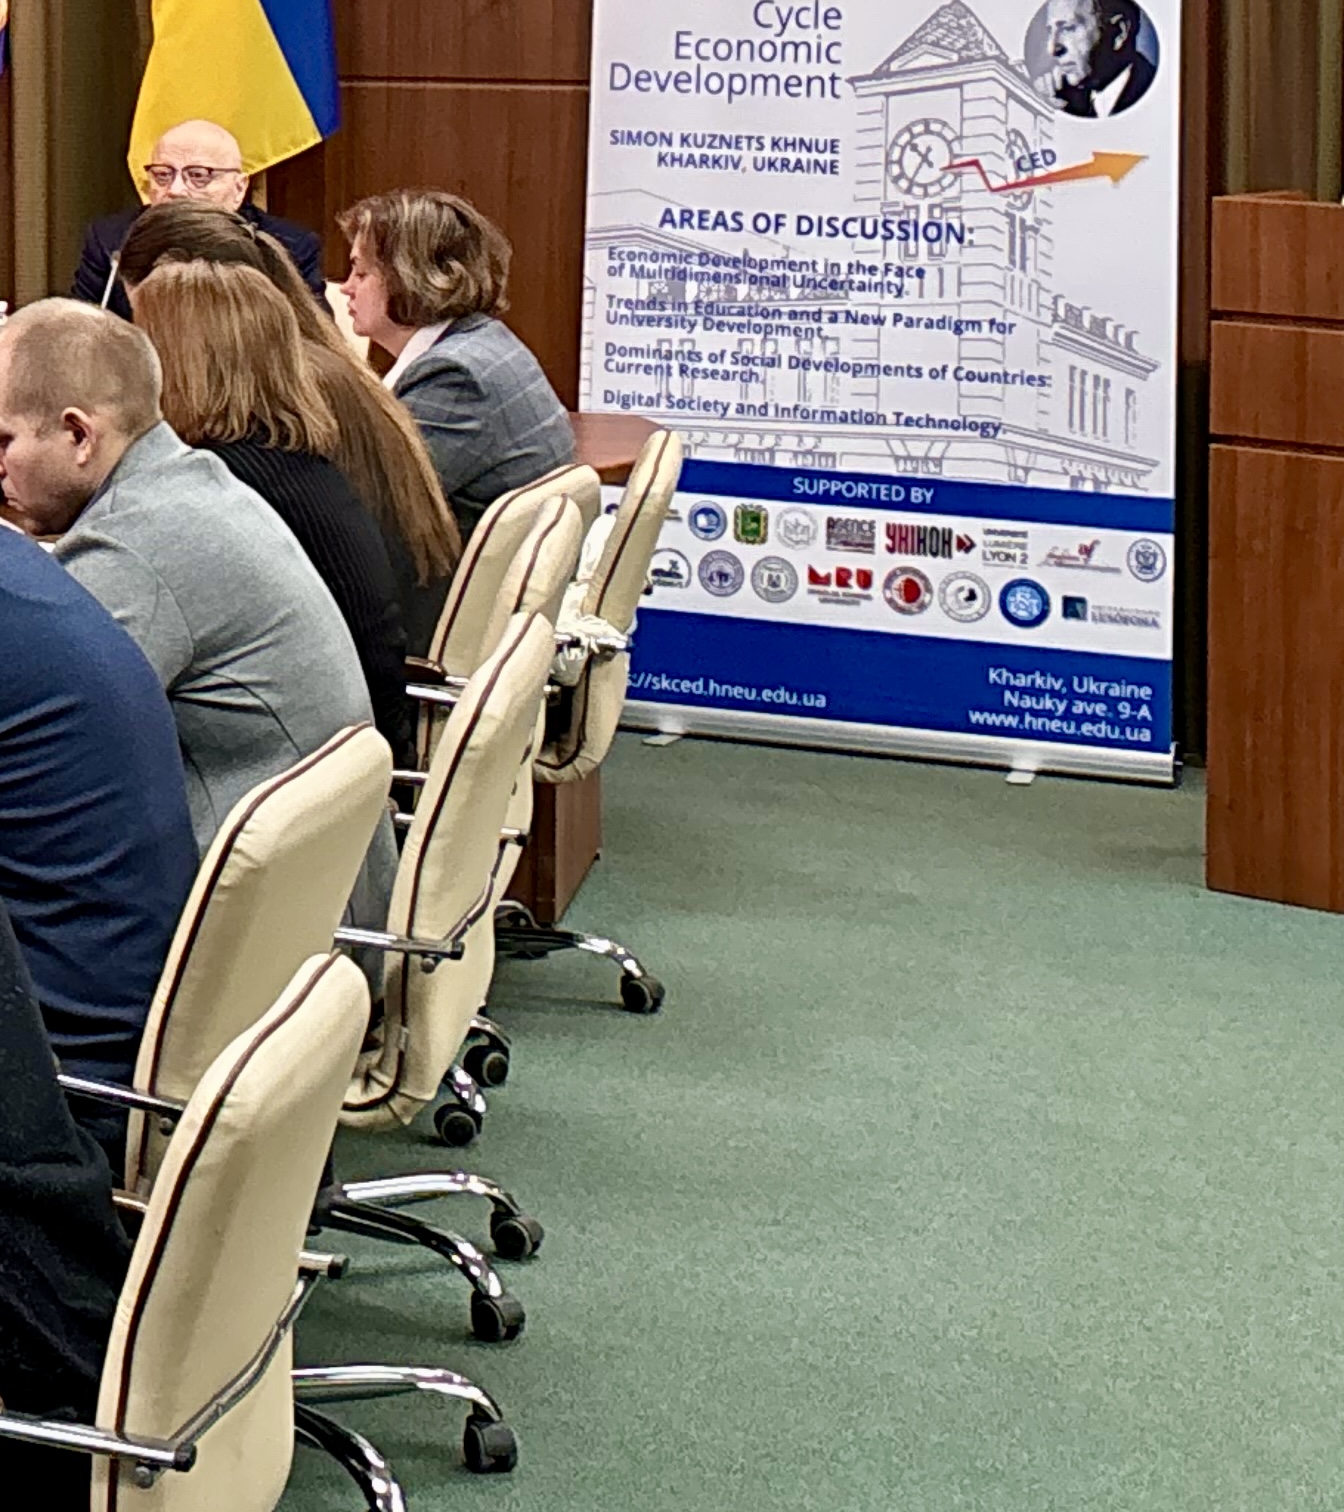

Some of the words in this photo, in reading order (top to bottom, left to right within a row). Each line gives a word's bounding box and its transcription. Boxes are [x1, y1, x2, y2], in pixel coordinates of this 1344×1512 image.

[674, 31, 842, 64] Economic
[610, 62, 842, 104] Development
[610, 129, 674, 148] SIMON
[680, 132, 766, 151] KUZNETS
[771, 136, 840, 155] KHNUE
[657, 152, 747, 174] KHARKIV,
[753, 156, 840, 176] UKRAINE
[1016, 148, 1057, 172] CED
[658, 208, 744, 232] AREAS
[752, 212, 787, 235] OF
[796, 215, 975, 246] DISCUSSION:
[608, 246, 692, 266] Economic
[698, 252, 818, 274] Development
[824, 258, 841, 275] in
[848, 260, 879, 277] the
[884, 262, 926, 279] Face
[607, 263, 625, 278] of
[629, 264, 788, 287] Multidimensional
[793, 274, 910, 298] Uncertainty.
[606, 310, 698, 334] University
[607, 294, 668, 312] Trends
[672, 298, 688, 314] in
[694, 300, 782, 320] Education
[788, 306, 822, 323] and
[827, 312, 838, 324] a
[845, 310, 886, 326] New
[892, 312, 982, 335] Paradigm
[989, 318, 1016, 335] for
[604, 342, 703, 362] Dominants
[708, 349, 727, 364] of
[730, 351, 782, 369] Social
[788, 355, 923, 380] Developments
[928, 364, 948, 380] of
[604, 358, 674, 378] Current
[604, 390, 660, 410] Digital
[666, 395, 731, 418] Society
[736, 401, 768, 418] and
[774, 403, 887, 426] Information
[793, 477, 906, 502] SUPPORTED
[910, 486, 935, 504] BY
[982, 550, 1016, 564] LYON
[1020, 552, 1029, 565] 2
[988, 668, 1067, 694] Kharkiv,
[1072, 676, 1153, 700] Ukraine
[1004, 690, 1068, 716] Nauky
[1072, 699, 1113, 718] ave.
[1118, 701, 1153, 721] 9-A
[968, 710, 1152, 742] www.hneu.edu.ua
